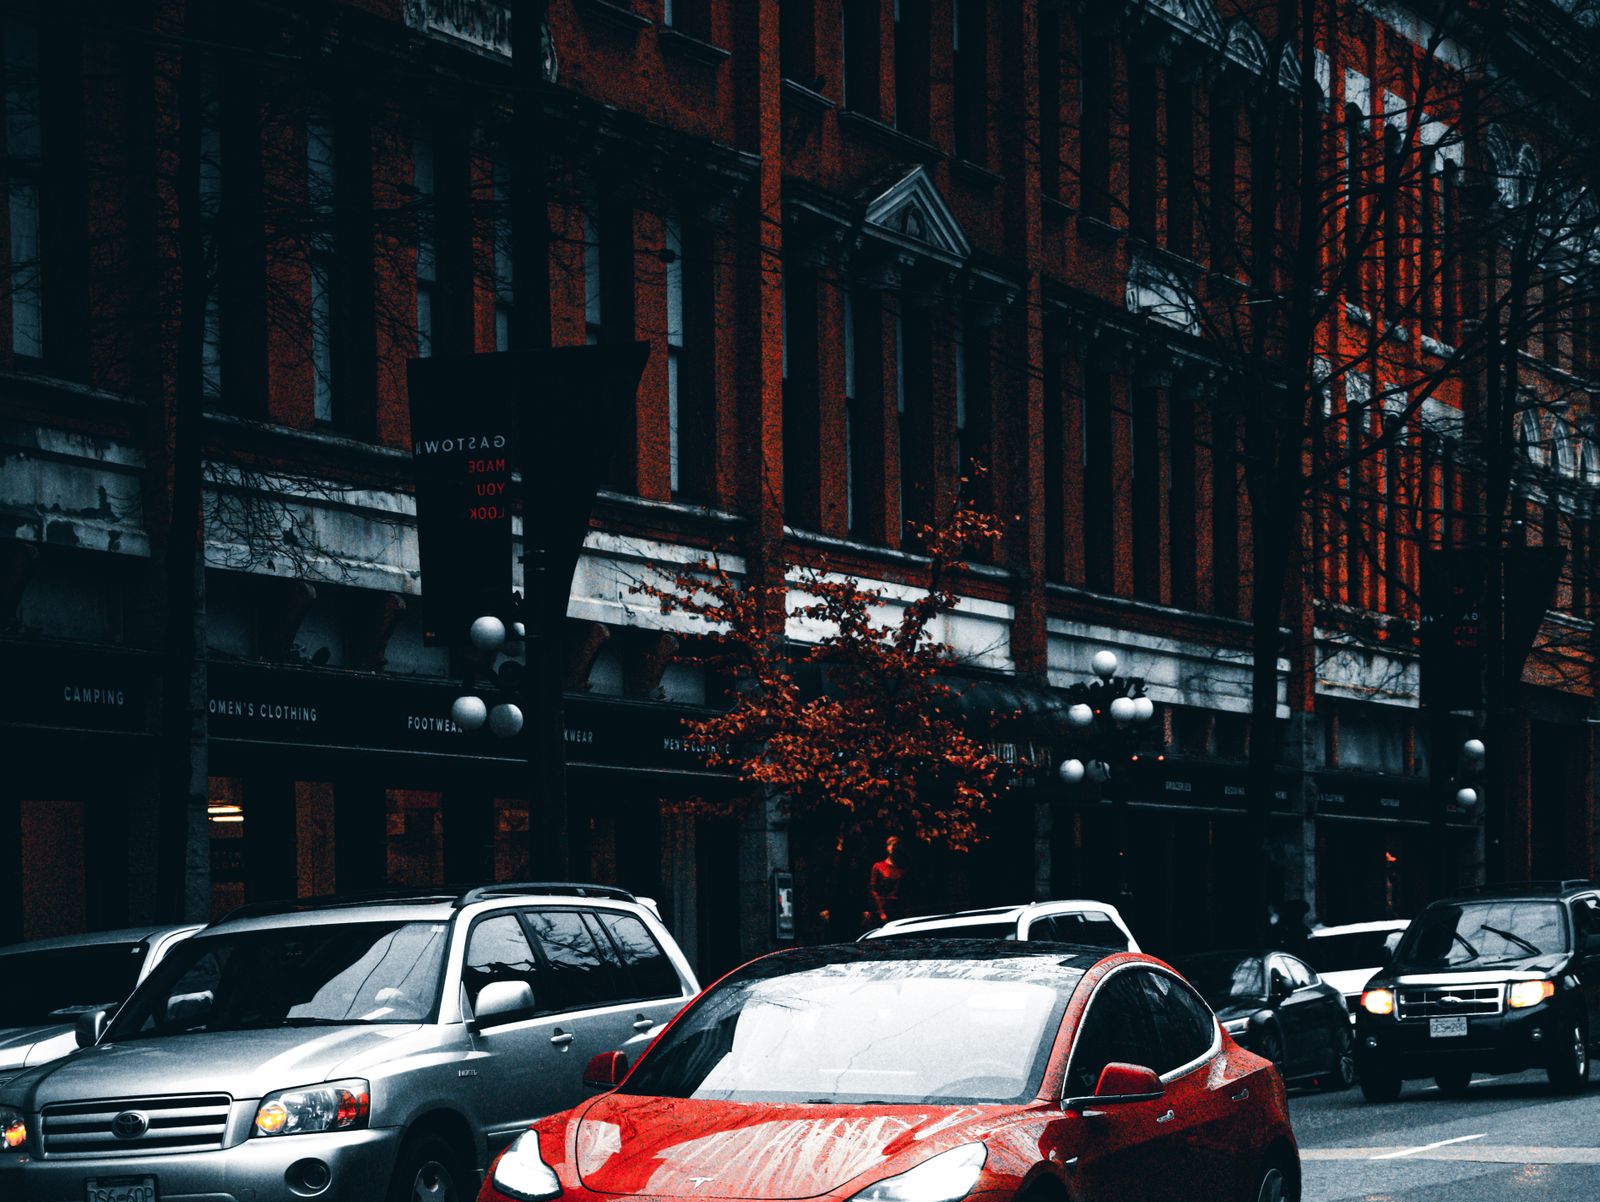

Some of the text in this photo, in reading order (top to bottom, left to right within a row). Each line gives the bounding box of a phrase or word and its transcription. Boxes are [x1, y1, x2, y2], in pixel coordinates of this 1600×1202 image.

[63, 686, 126, 706] CAMPING
[208, 699, 318, 723] OMEN'S CLOTHING
[563, 729, 593, 744] KWEAR
